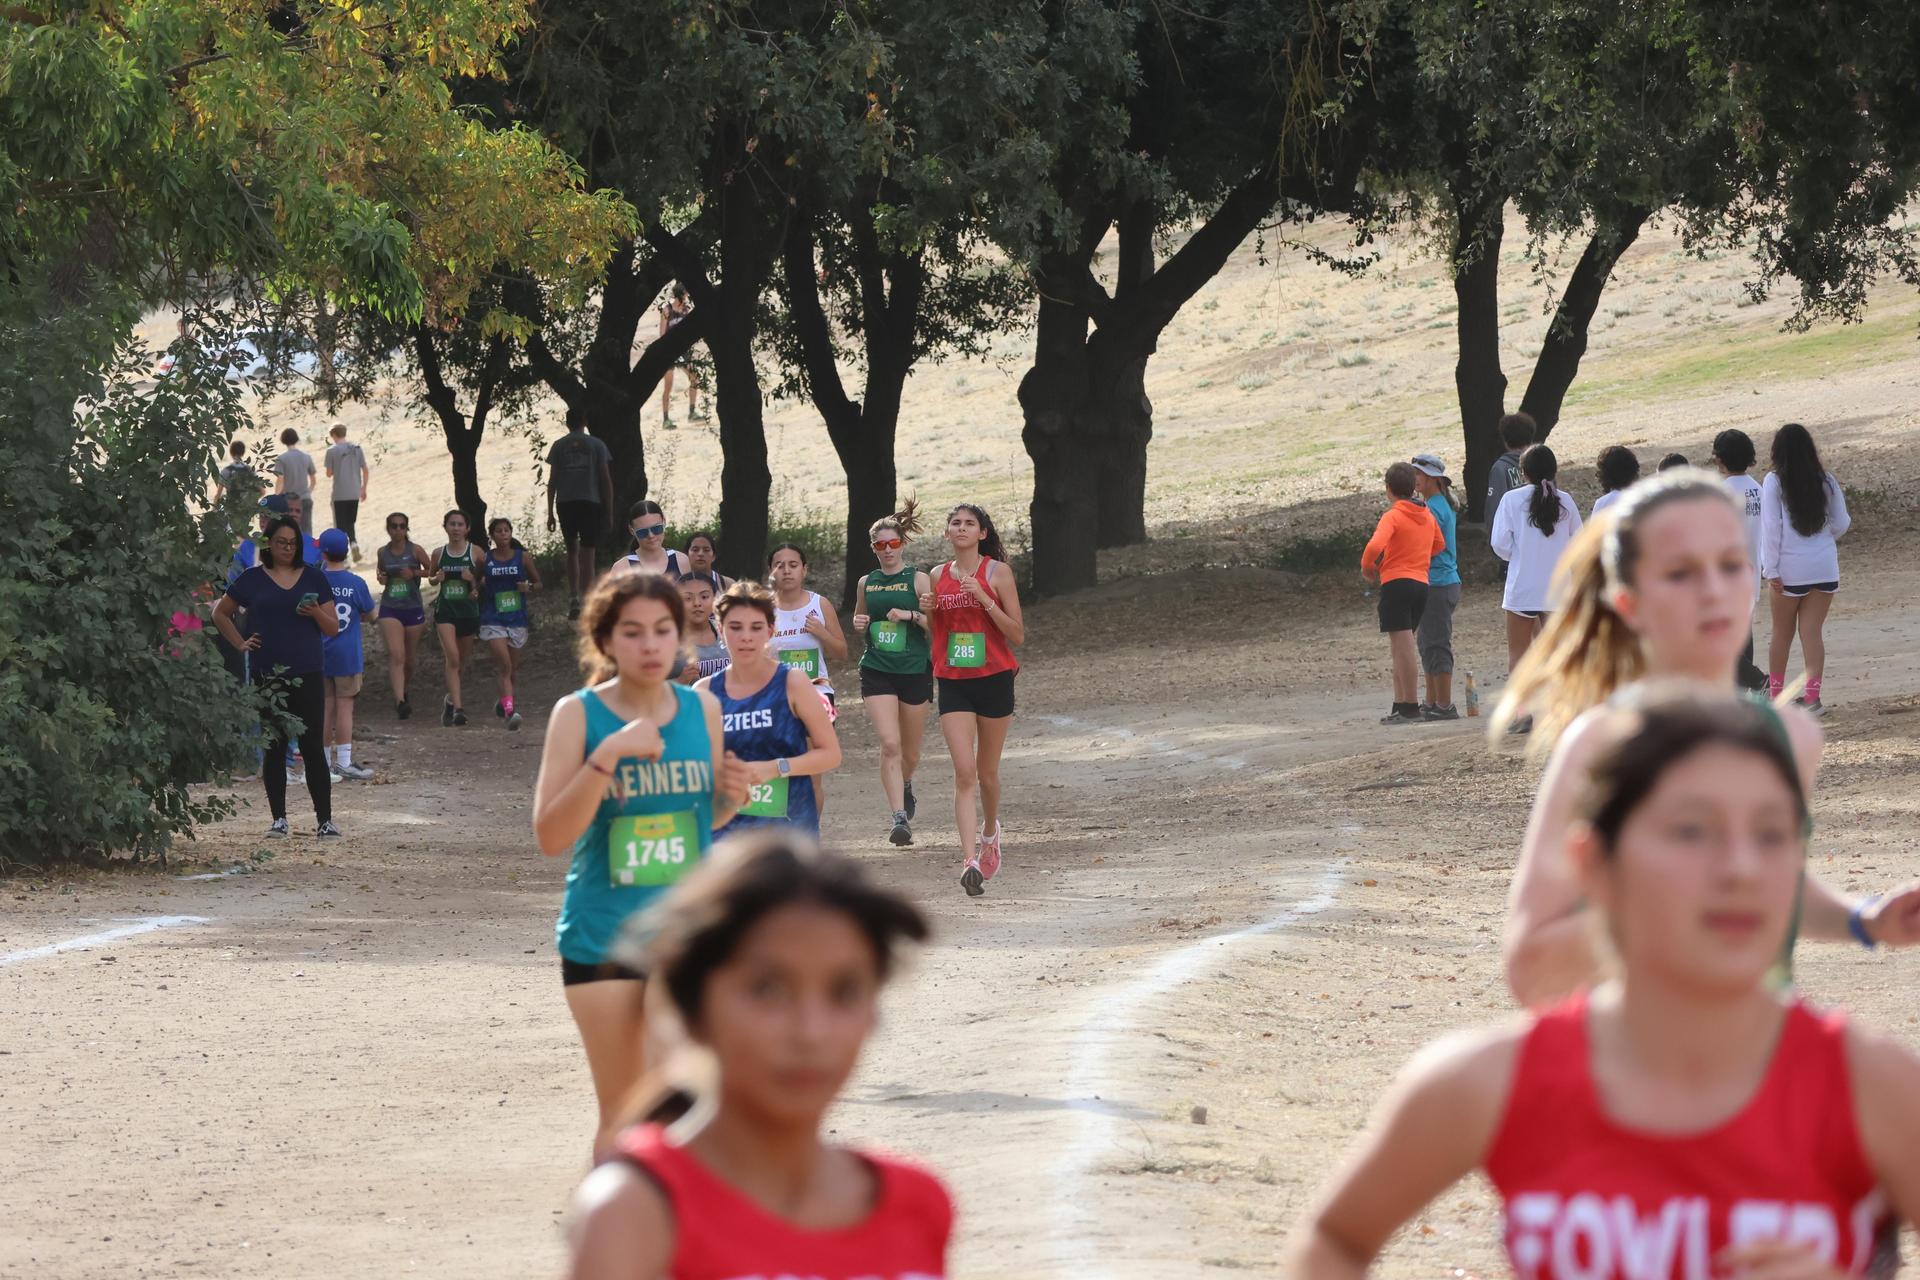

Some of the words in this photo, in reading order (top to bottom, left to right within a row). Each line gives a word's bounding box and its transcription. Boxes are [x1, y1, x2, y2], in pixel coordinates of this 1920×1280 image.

[1745, 488, 1759, 498] EAT
[1745, 502, 1761, 511] RUN
[491, 566, 518, 576] AZTECS
[341, 587, 354, 597] OF
[501, 598, 516, 607] 564
[335, 602, 352, 632] 8
[878, 631, 897, 643] 937
[954, 645, 975, 658] 285
[721, 708, 773, 732] ZTECS
[625, 836, 685, 868] 1745
